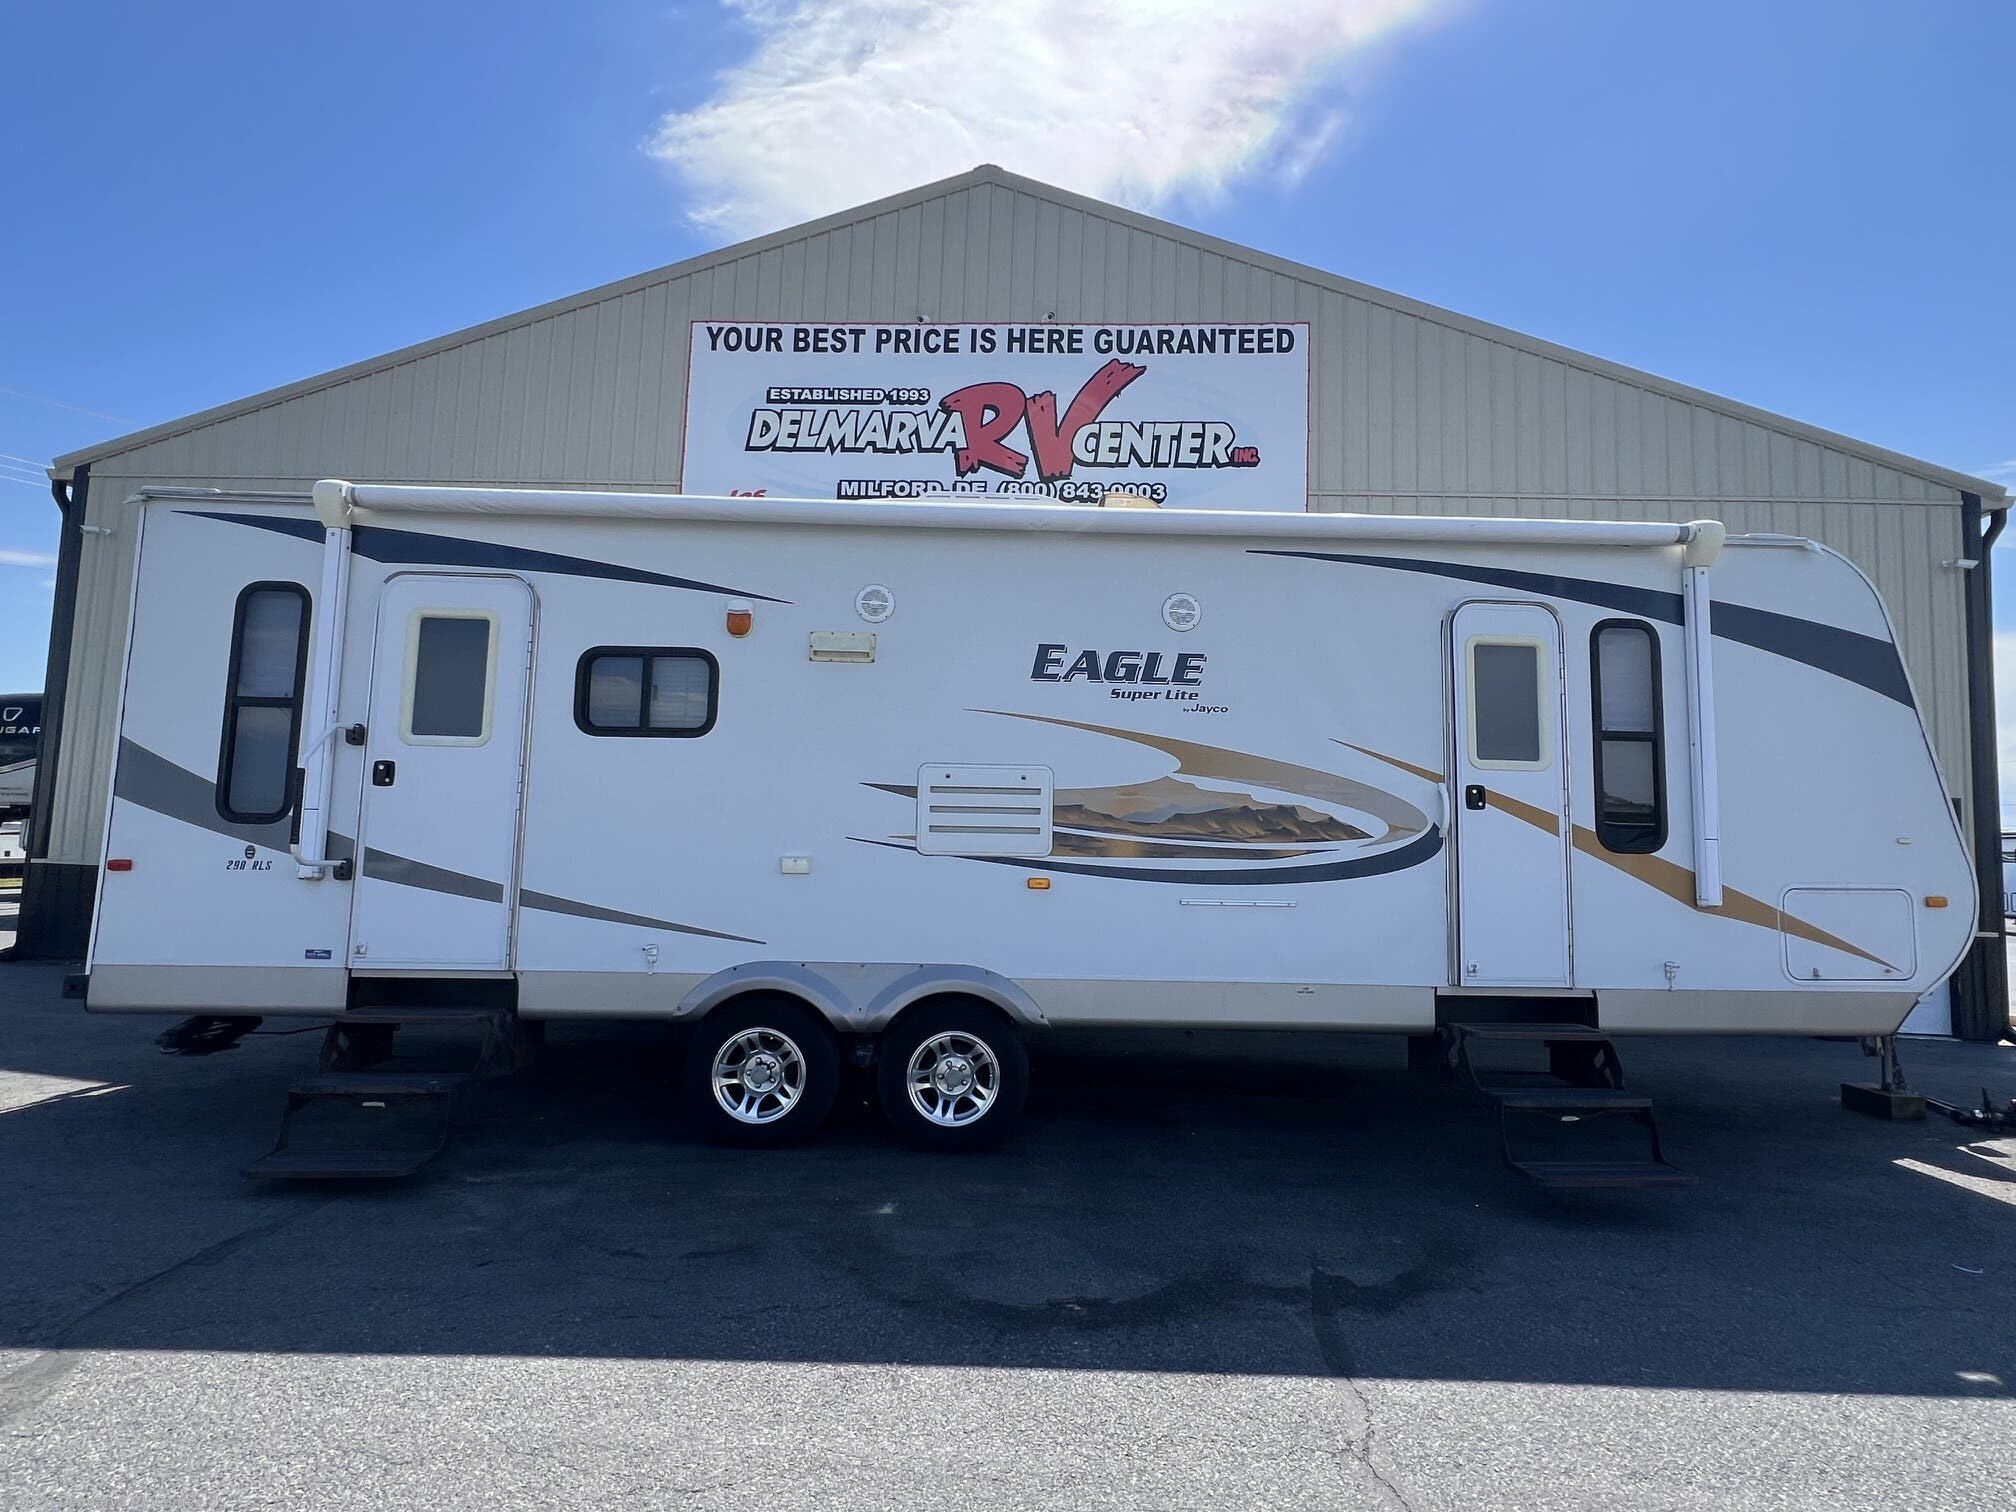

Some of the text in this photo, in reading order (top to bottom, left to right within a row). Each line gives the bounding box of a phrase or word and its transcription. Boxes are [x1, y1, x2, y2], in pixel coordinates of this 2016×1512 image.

[706, 326, 1295, 354] YOUR BEST PRICE IS HERE GUARANTEED
[768, 387, 931, 404] ESTABLISHED 1993
[745, 408, 969, 454] DELMARVA
[939, 358, 1147, 482] RV
[1071, 421, 1236, 468] CENTER
[996, 481, 1060, 500] (800)
[1059, 482, 1167, 502] 843-0003
[1030, 643, 1207, 686] EAGLE
[1110, 688, 1199, 702] Super Lite
[1190, 703, 1229, 714] Jayco
[251, 860, 273, 871] RLS
